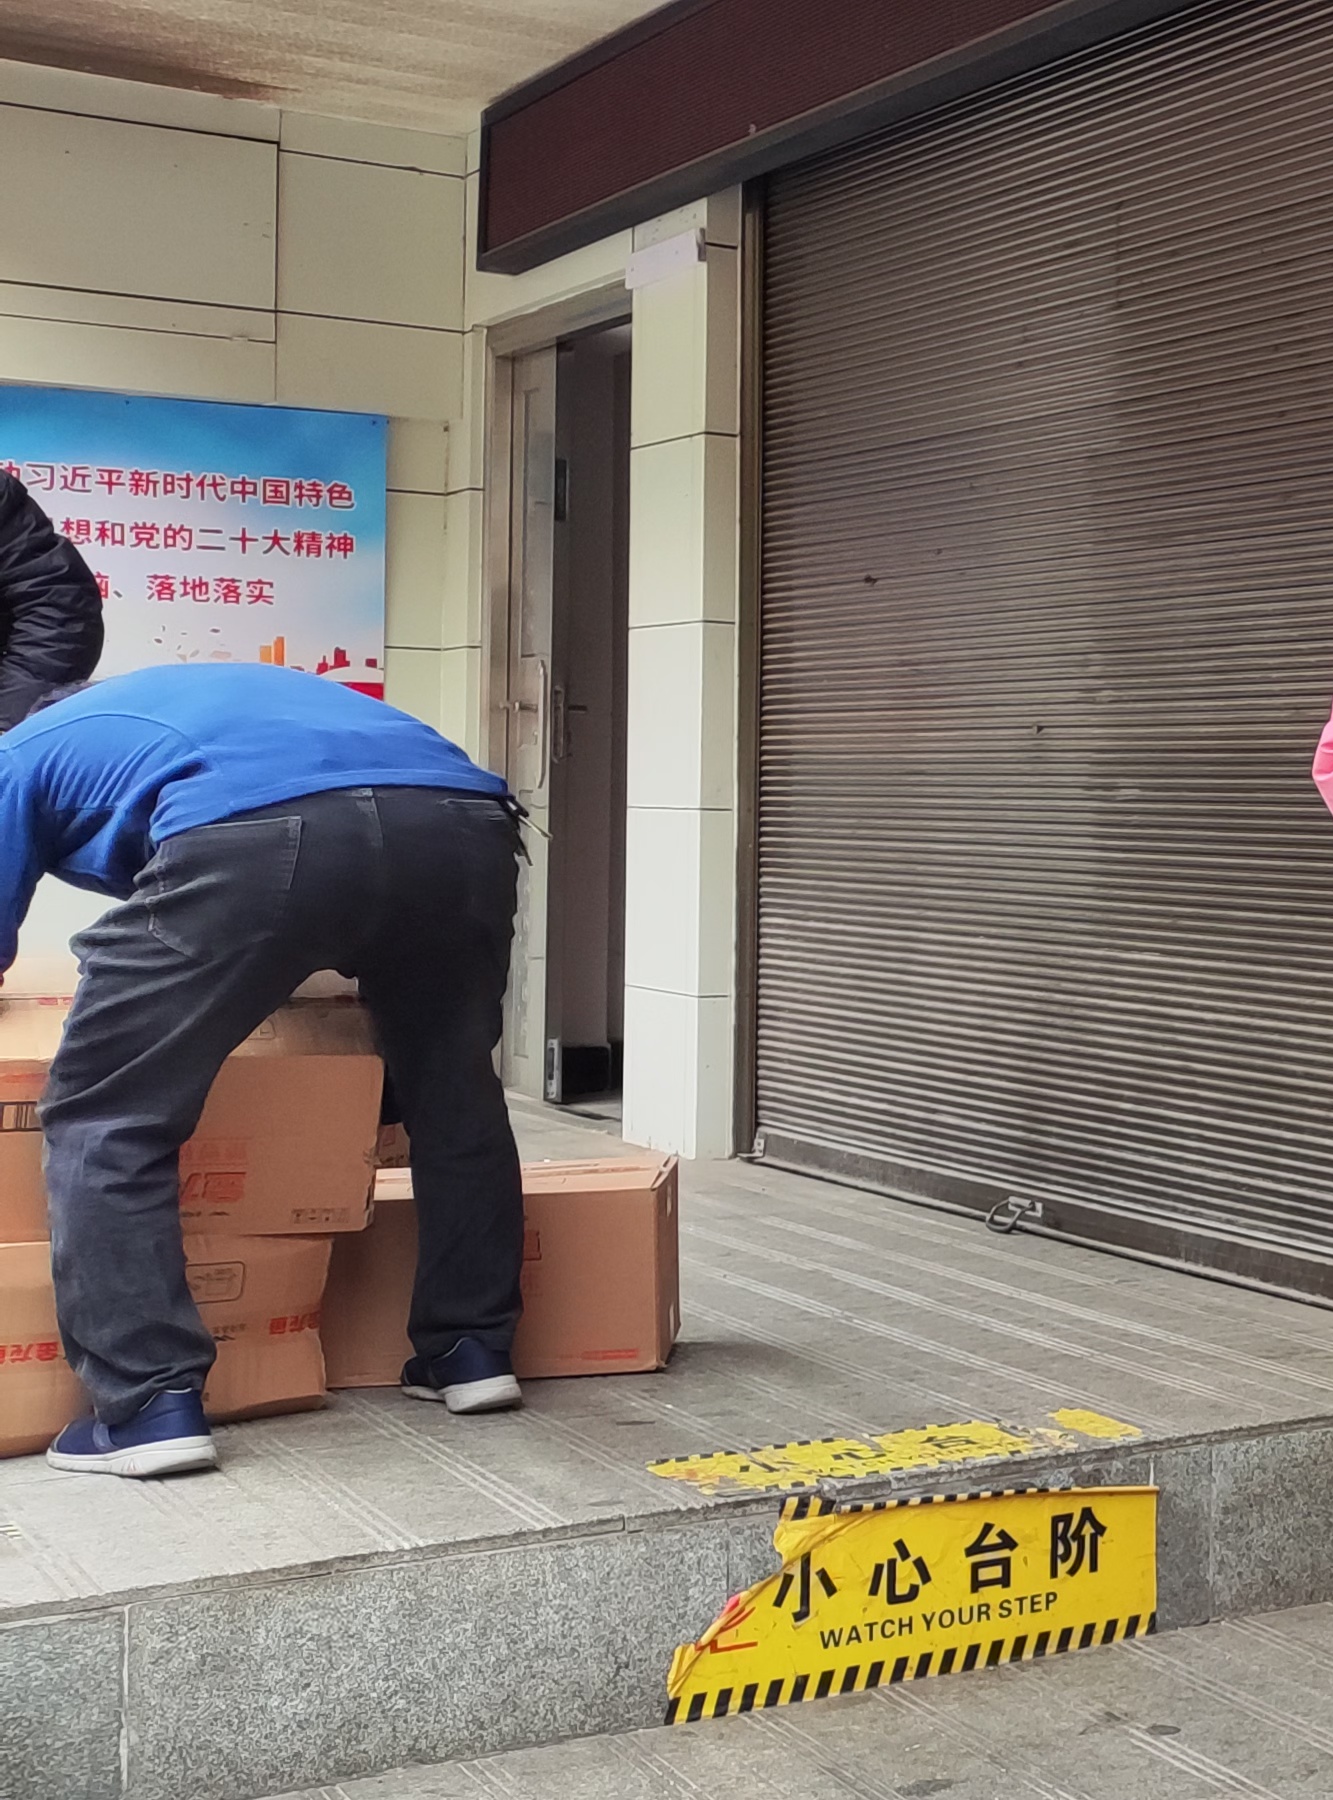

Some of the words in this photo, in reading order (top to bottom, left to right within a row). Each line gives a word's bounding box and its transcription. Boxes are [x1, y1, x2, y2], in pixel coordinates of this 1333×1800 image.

[49, 517, 355, 560] 想和党的二十大精神
[0, 1341, 58, 1365] 金龙
[773, 1506, 1107, 1623] 小心台阶
[820, 1616, 913, 1649] WATCH
[921, 1603, 991, 1631] YOUR
[998, 1592, 1058, 1618] STEP
